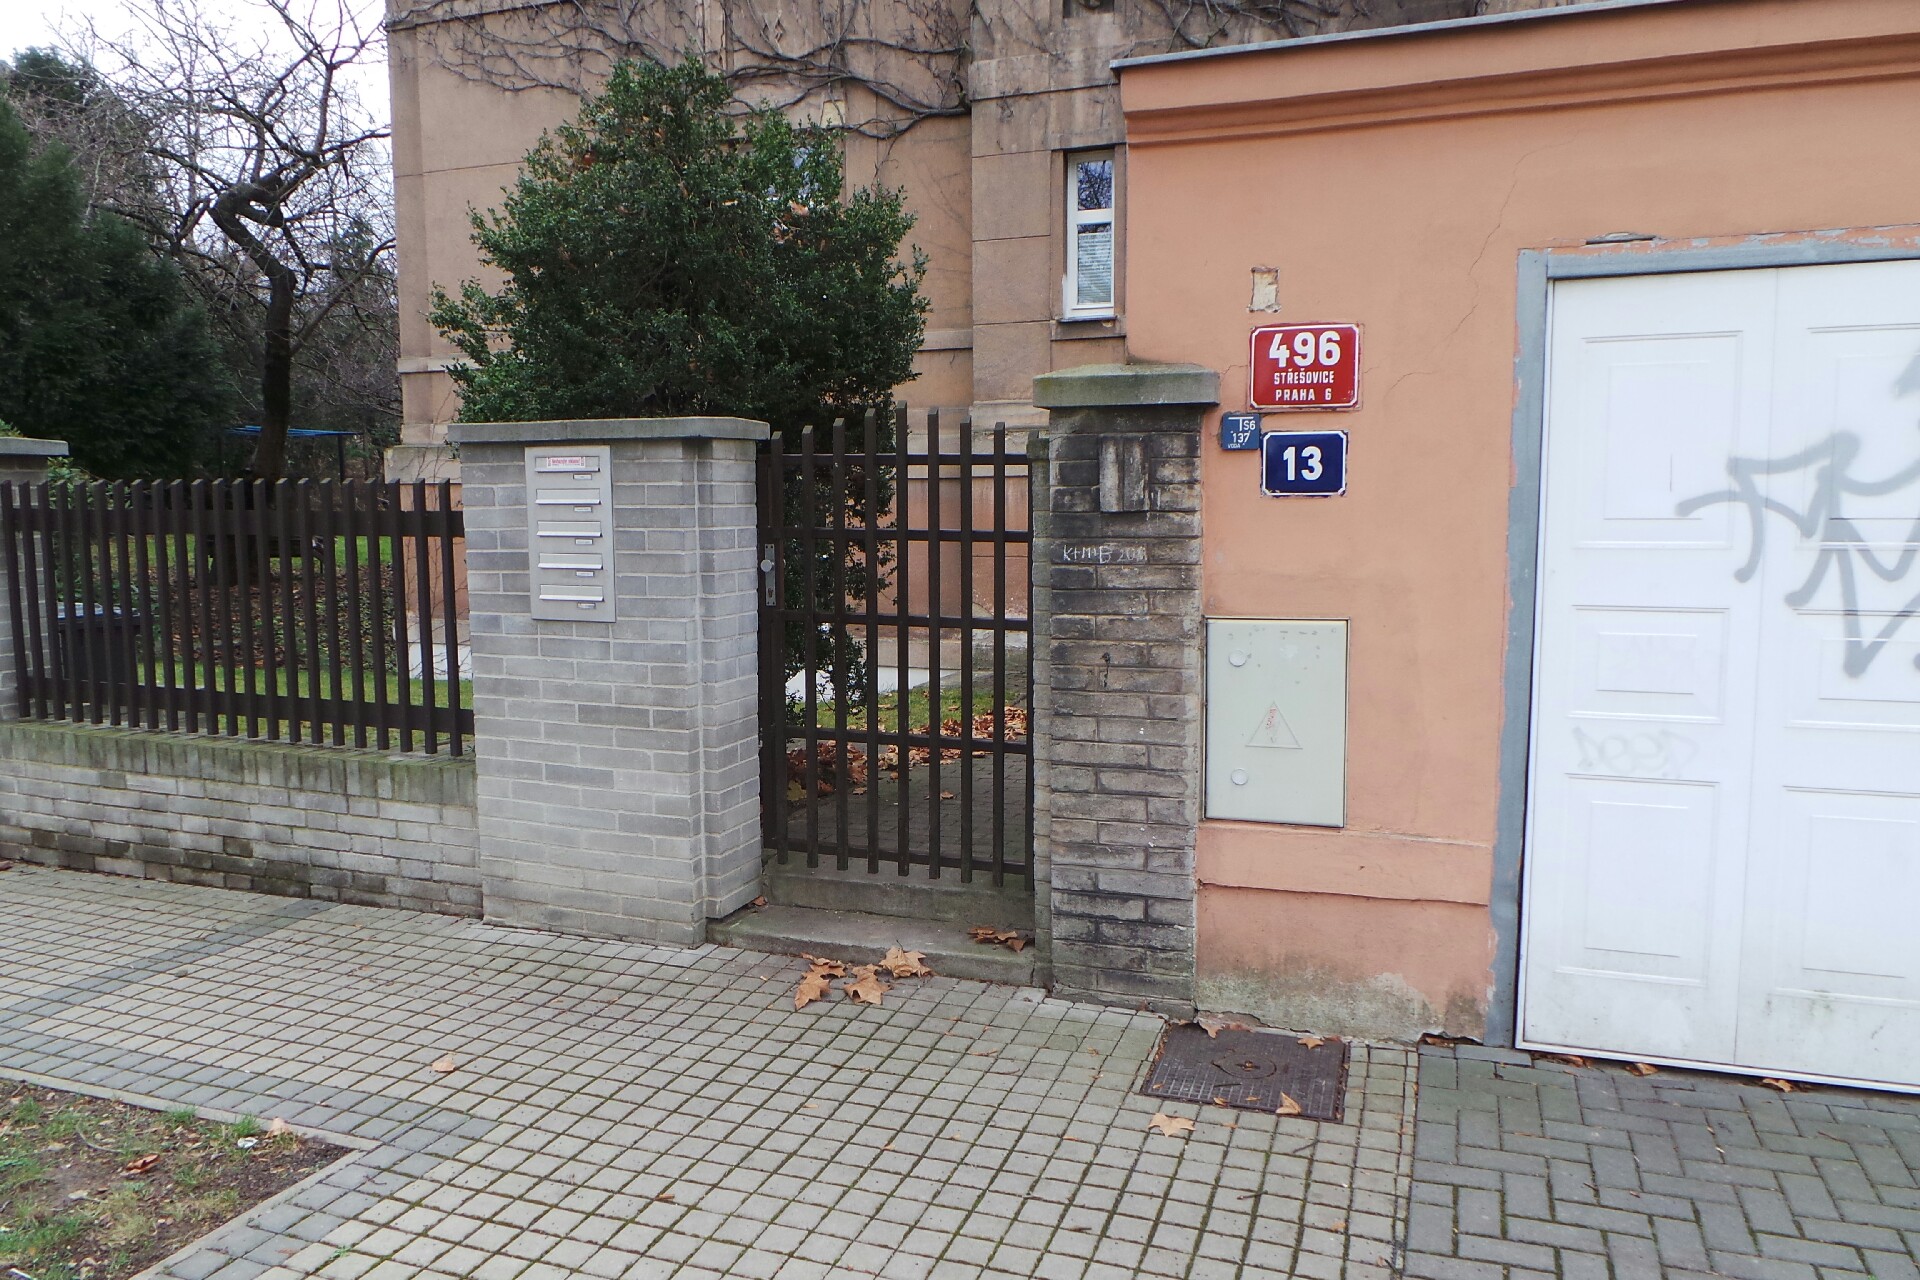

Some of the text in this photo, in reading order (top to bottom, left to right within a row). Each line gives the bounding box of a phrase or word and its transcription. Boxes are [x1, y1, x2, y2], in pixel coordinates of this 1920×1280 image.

[1269, 330, 1341, 368] 496
[1273, 368, 1335, 385] STŘEŠOVICE
[1275, 387, 1332, 401] PRAHA 6
[1232, 431, 1251, 443] 137
[1283, 445, 1323, 481] 13
